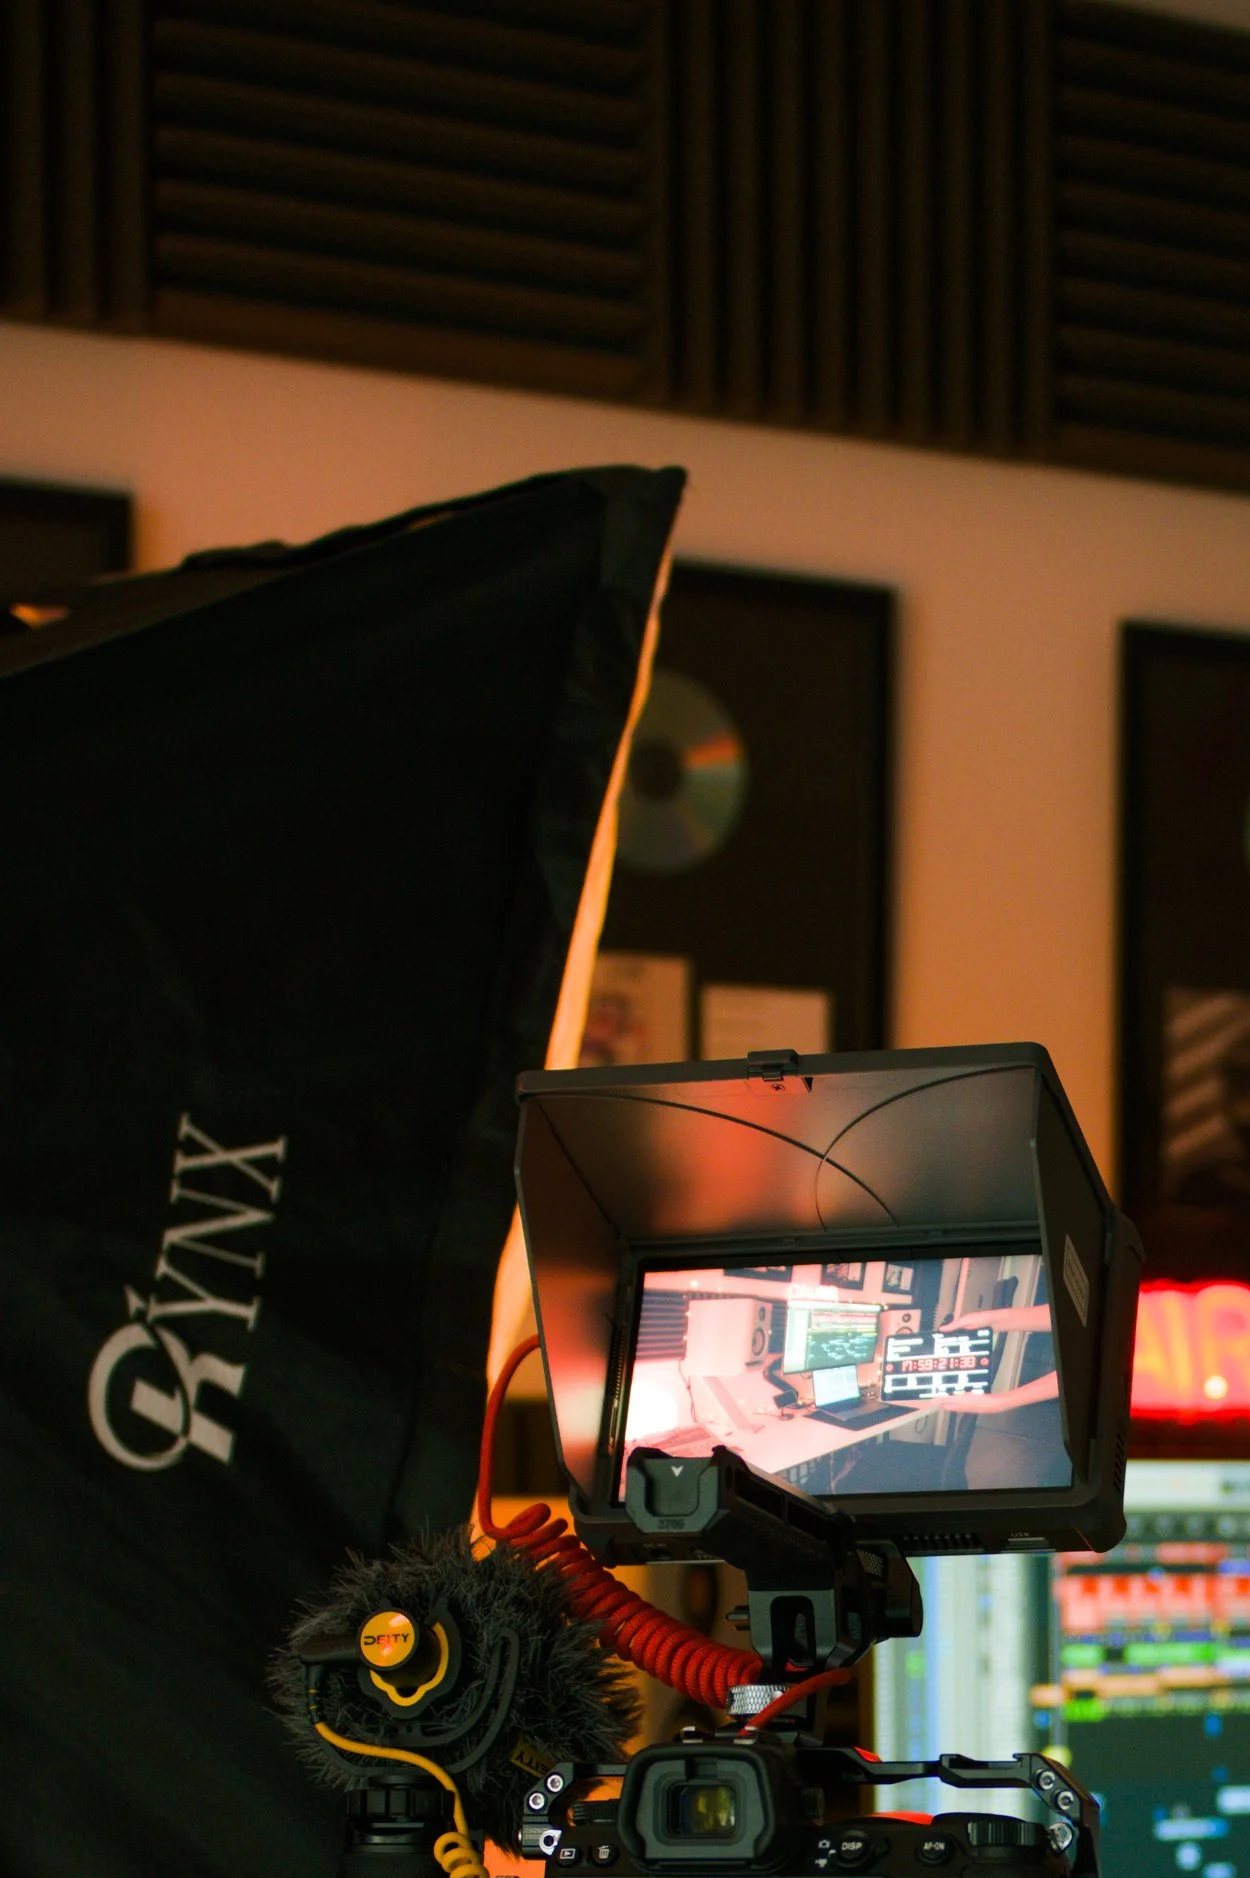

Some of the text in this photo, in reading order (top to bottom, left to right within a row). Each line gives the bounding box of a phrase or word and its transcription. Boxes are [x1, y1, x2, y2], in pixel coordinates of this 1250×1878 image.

[363, 1633, 410, 1646] DEITY
[515, 1750, 550, 1776] EITY
[841, 1842, 863, 1851] DISP
[923, 1842, 945, 1850] AF-ON
